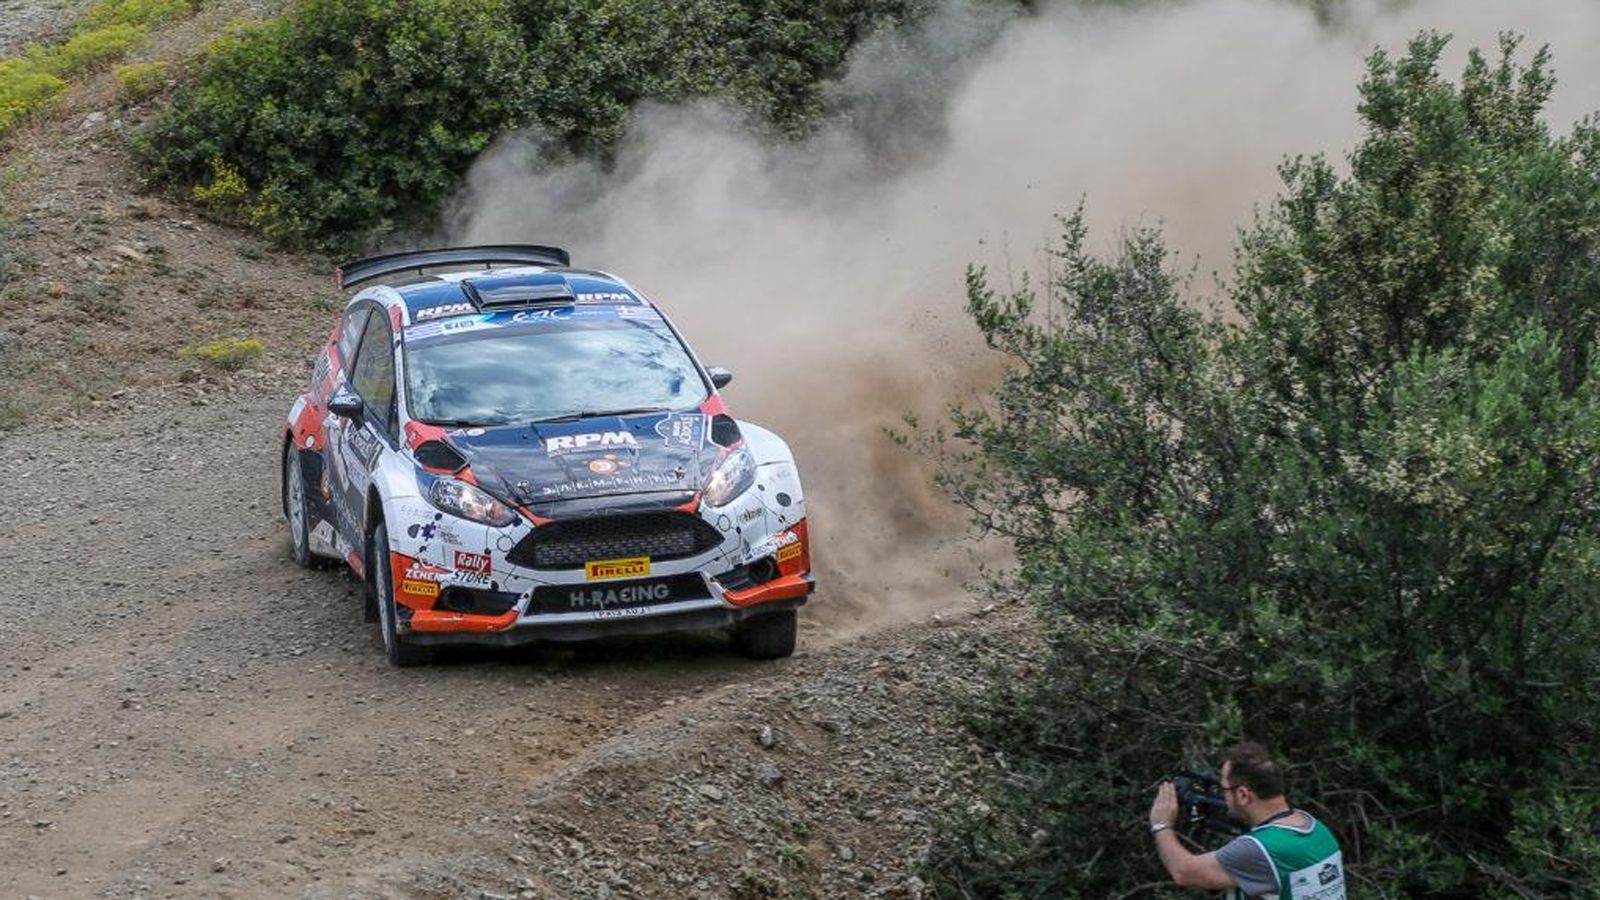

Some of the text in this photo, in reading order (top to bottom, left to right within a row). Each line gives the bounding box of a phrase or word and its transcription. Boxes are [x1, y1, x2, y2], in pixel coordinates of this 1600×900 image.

[576, 293, 631, 303] RPM
[417, 303, 472, 319] RPM
[546, 430, 639, 453] RPM
[457, 553, 489, 573] Rally
[591, 561, 645, 577] PIRELLI
[450, 569, 491, 585] STORE
[405, 582, 434, 595] PIRELLI
[569, 583, 670, 607] H-RACING
